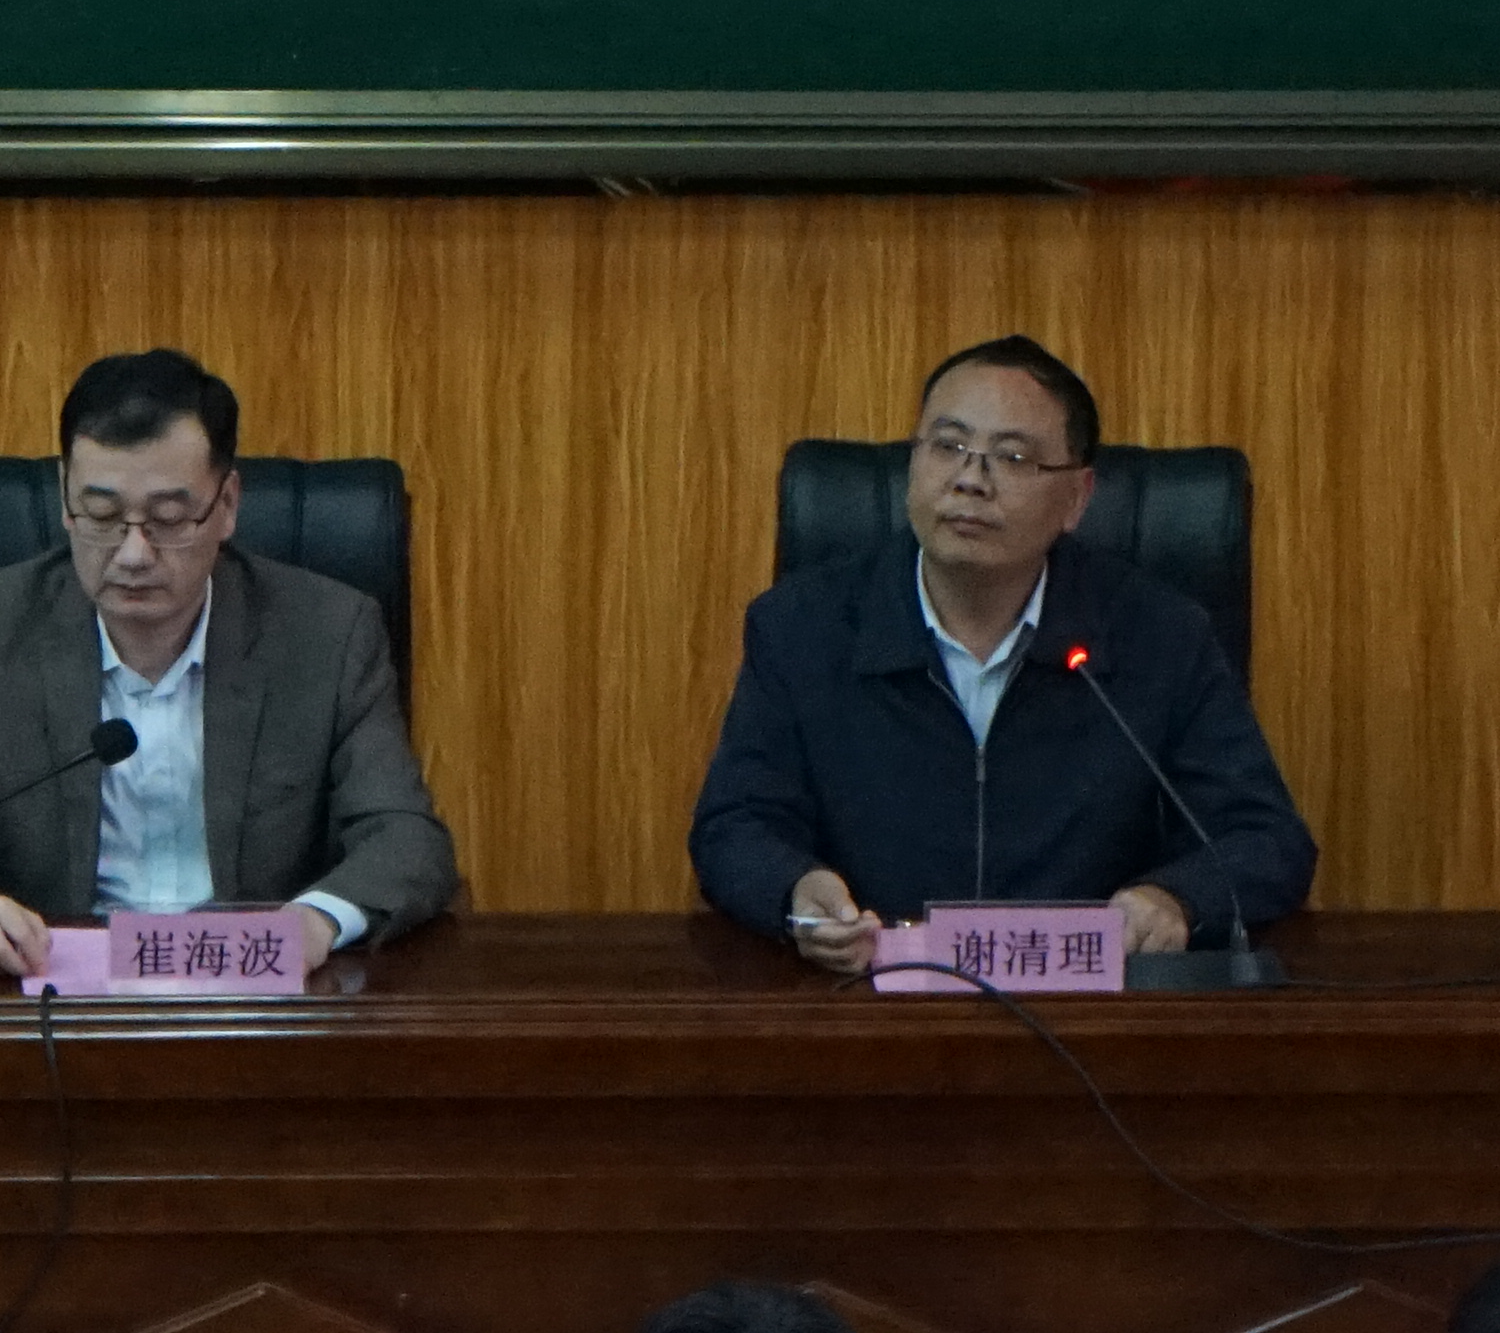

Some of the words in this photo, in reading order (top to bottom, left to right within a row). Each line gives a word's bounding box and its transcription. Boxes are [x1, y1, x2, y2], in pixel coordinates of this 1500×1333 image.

[131, 929, 286, 977] 崔海波
[952, 930, 1105, 976] 谢清理
